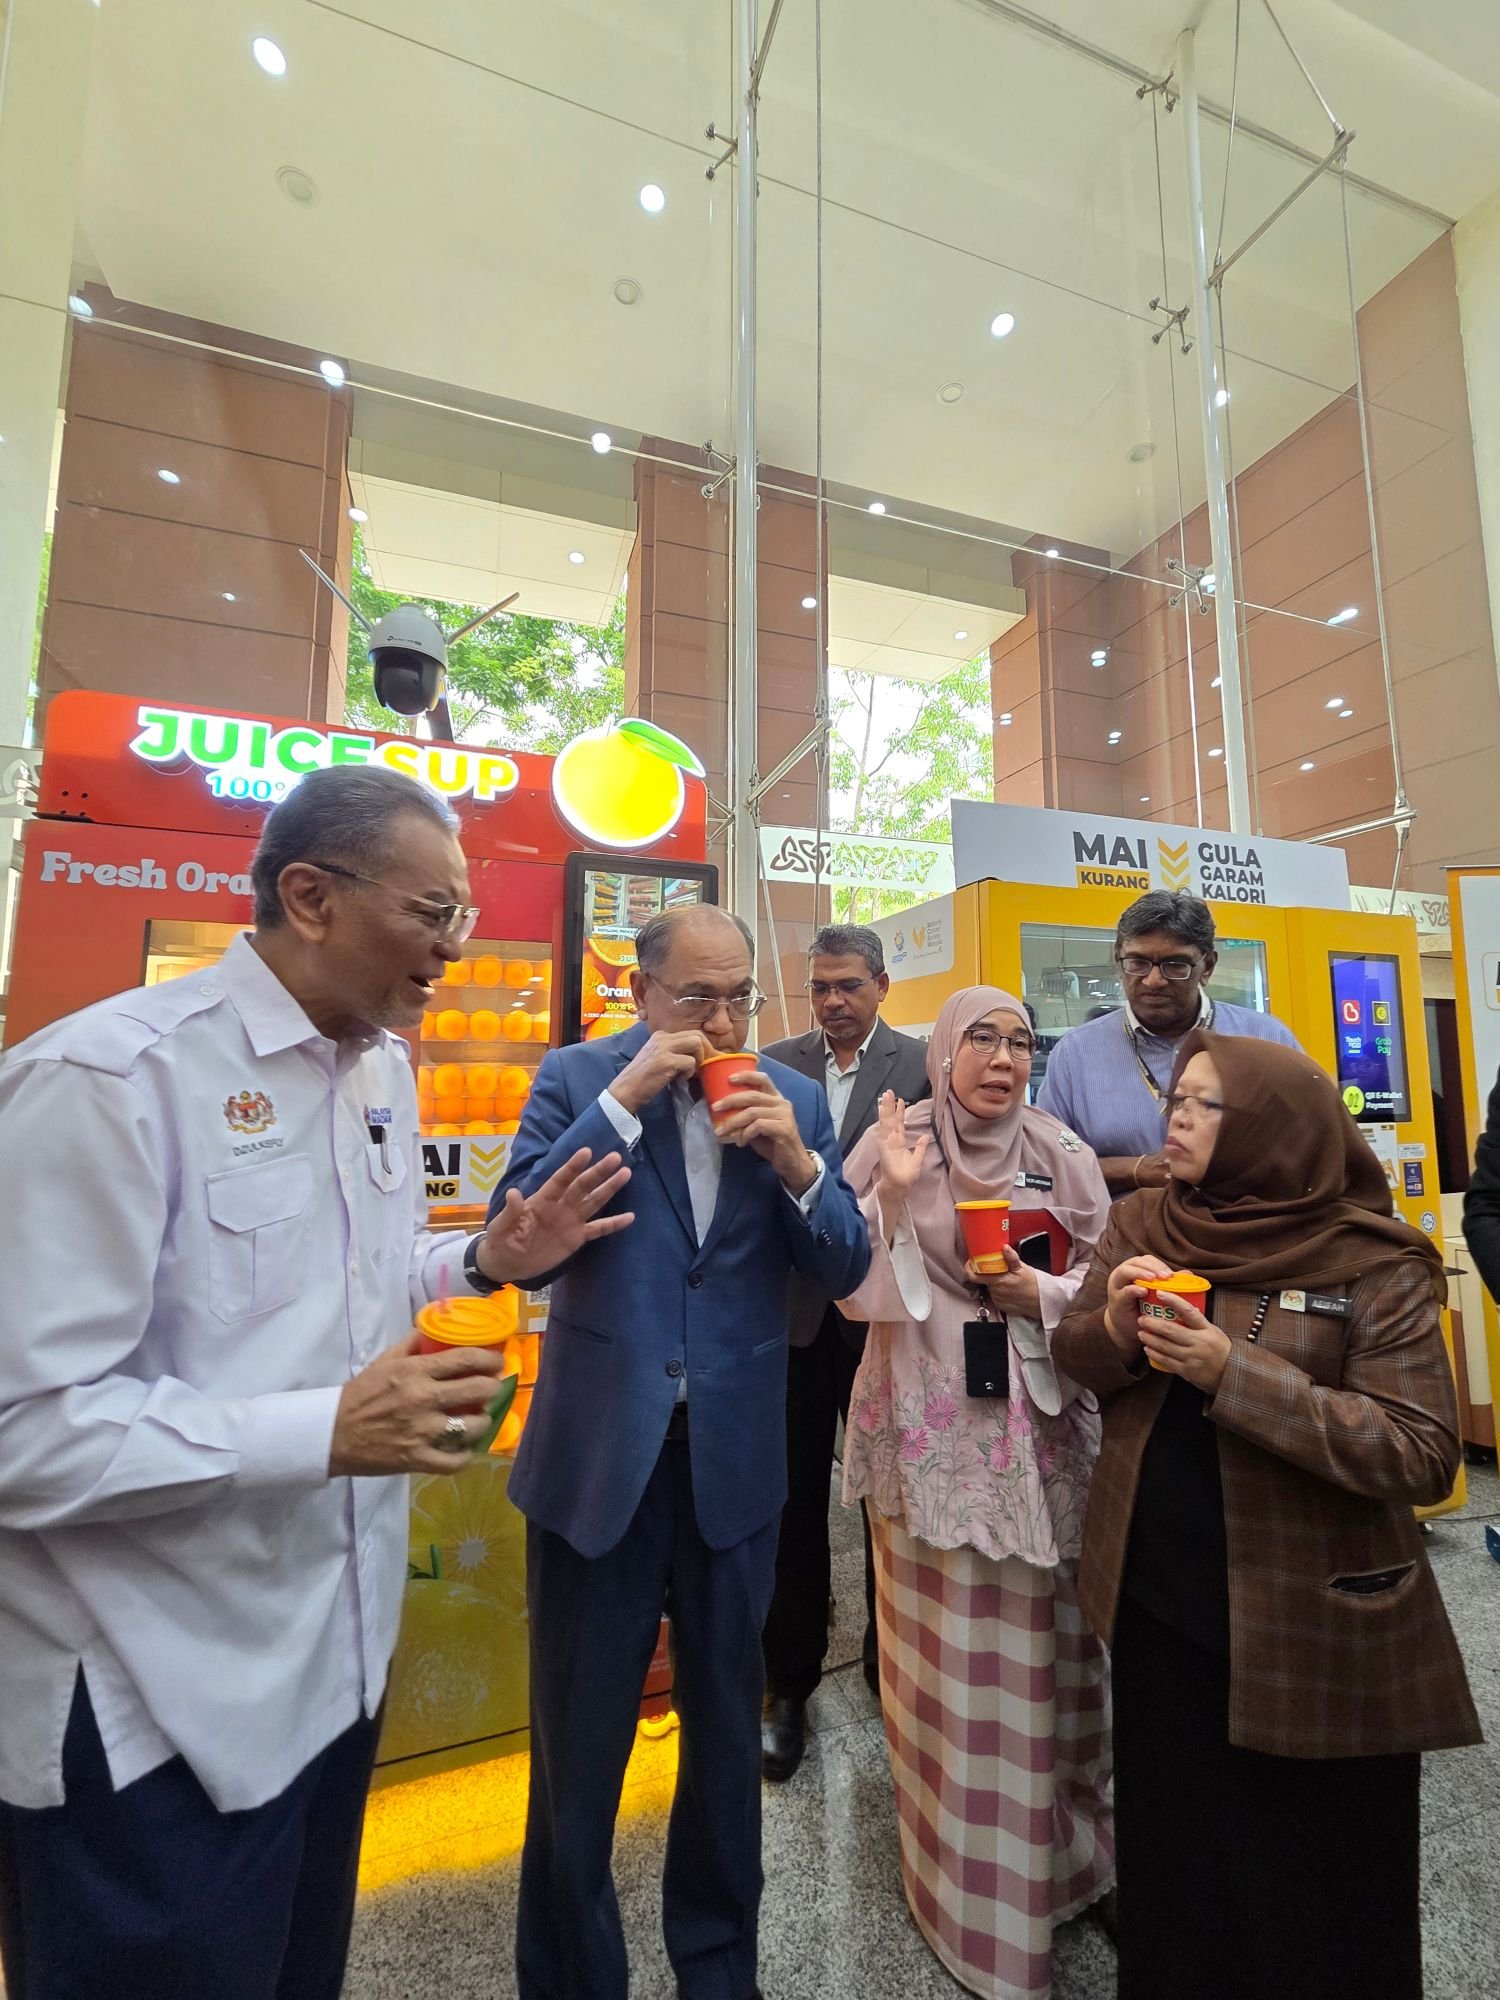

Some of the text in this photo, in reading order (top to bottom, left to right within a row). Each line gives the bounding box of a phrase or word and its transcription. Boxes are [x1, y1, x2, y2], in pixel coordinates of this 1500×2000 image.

[1073, 831, 1148, 869] MAI
[1198, 842, 1261, 868] GULA
[40, 851, 167, 889] Fresh
[1081, 871, 1149, 890] KURANG
[1200, 865, 1264, 886] GARAM
[1202, 883, 1265, 904] KALORI
